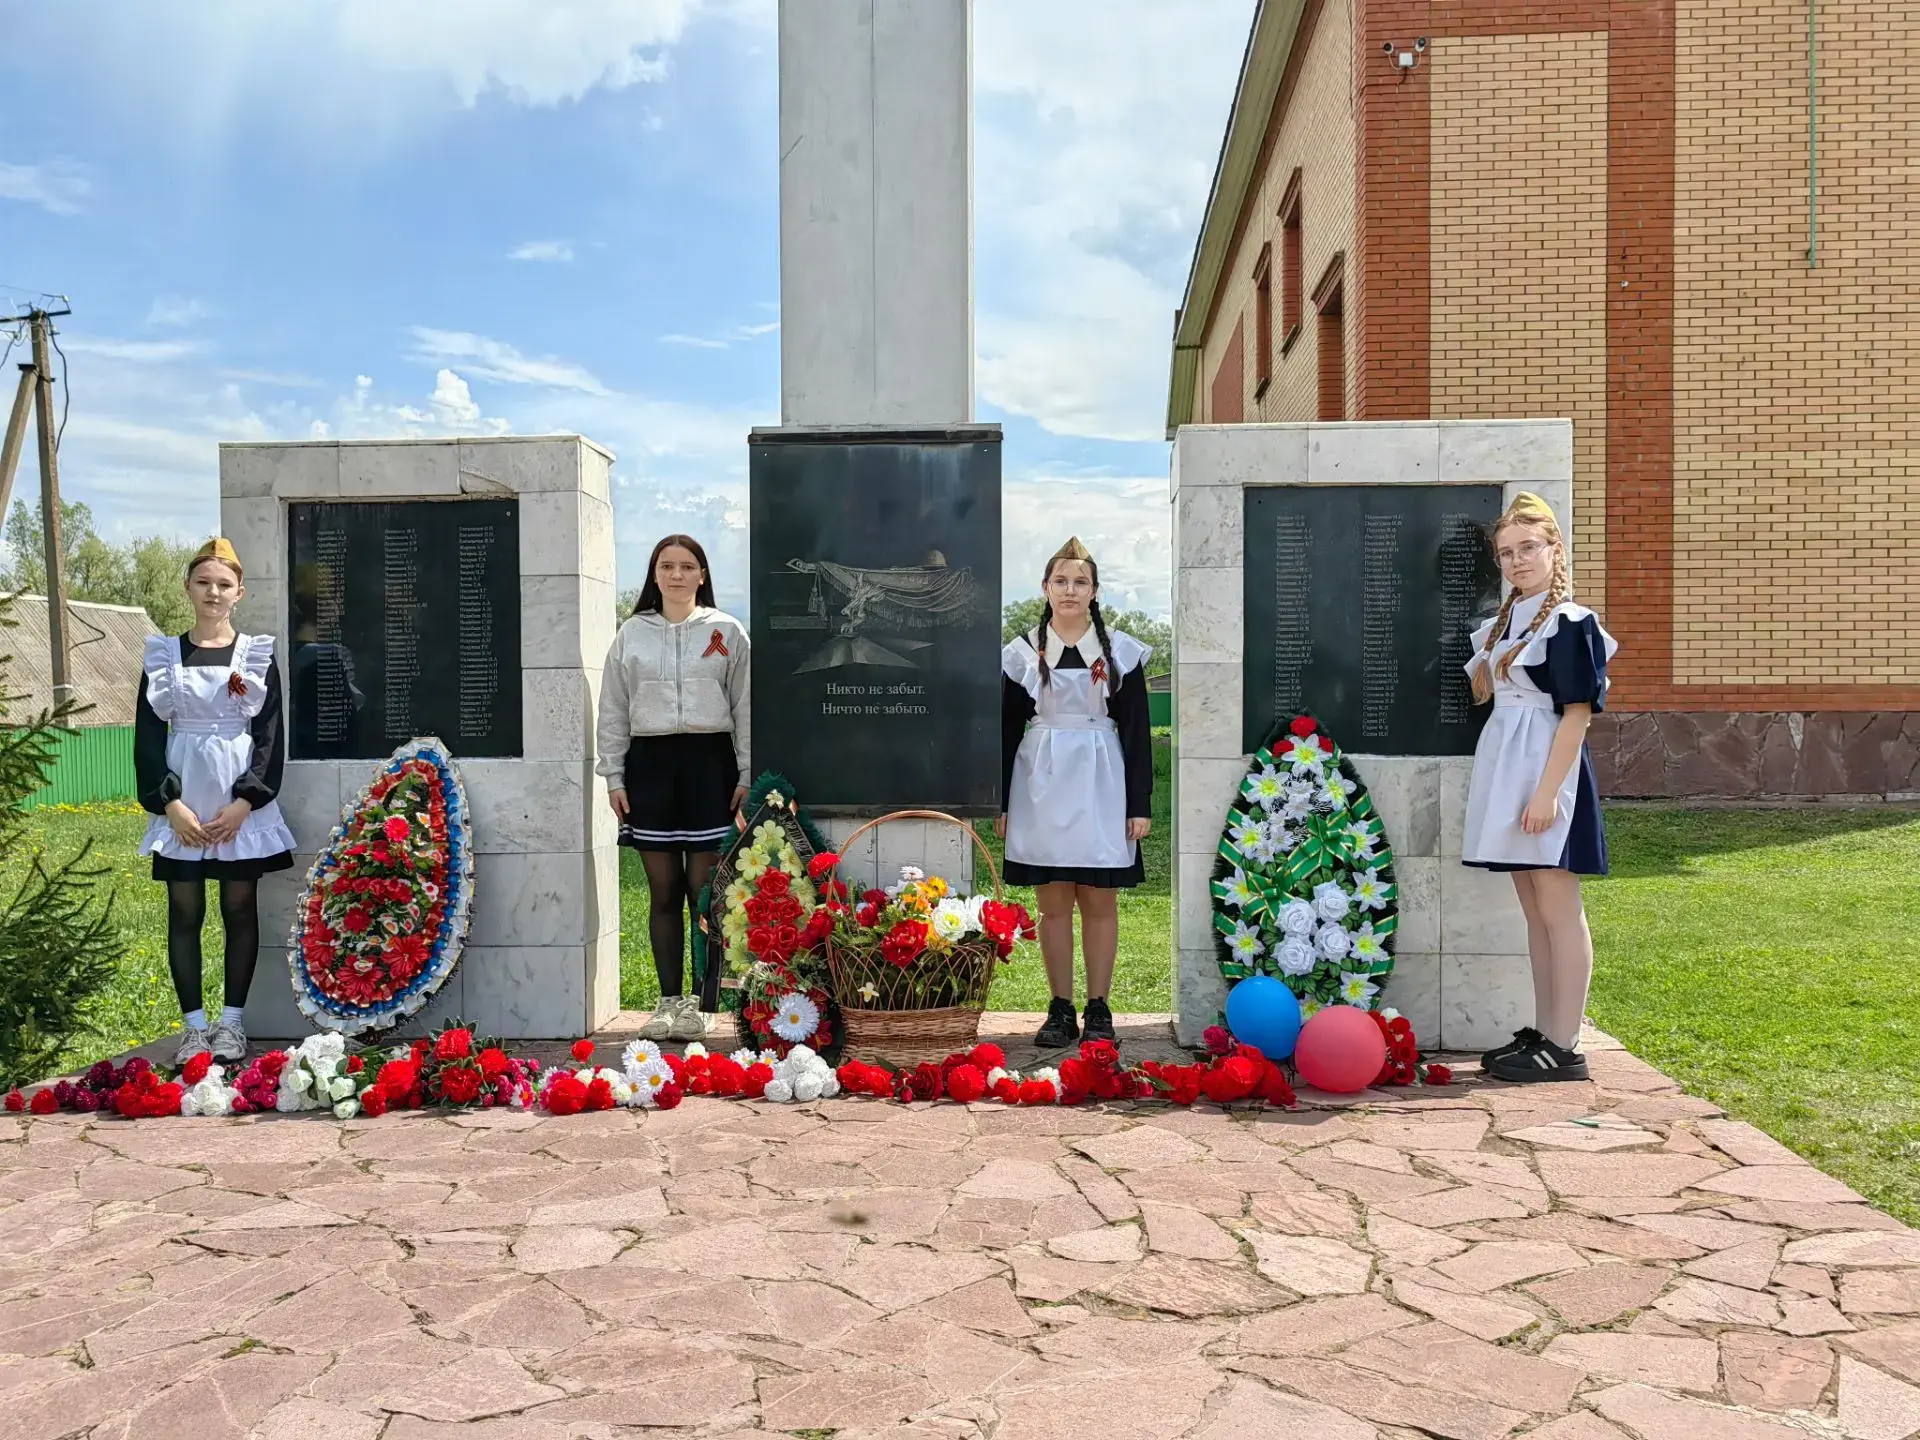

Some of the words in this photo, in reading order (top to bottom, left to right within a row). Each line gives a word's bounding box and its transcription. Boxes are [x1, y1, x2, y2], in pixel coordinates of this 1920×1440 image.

[826, 683, 865, 695] Никто
[869, 686, 883, 695] не
[886, 682, 926, 695] забыт.
[822, 702, 862, 714] Ничто
[865, 705, 880, 714] не
[882, 702, 930, 714] забыто.
